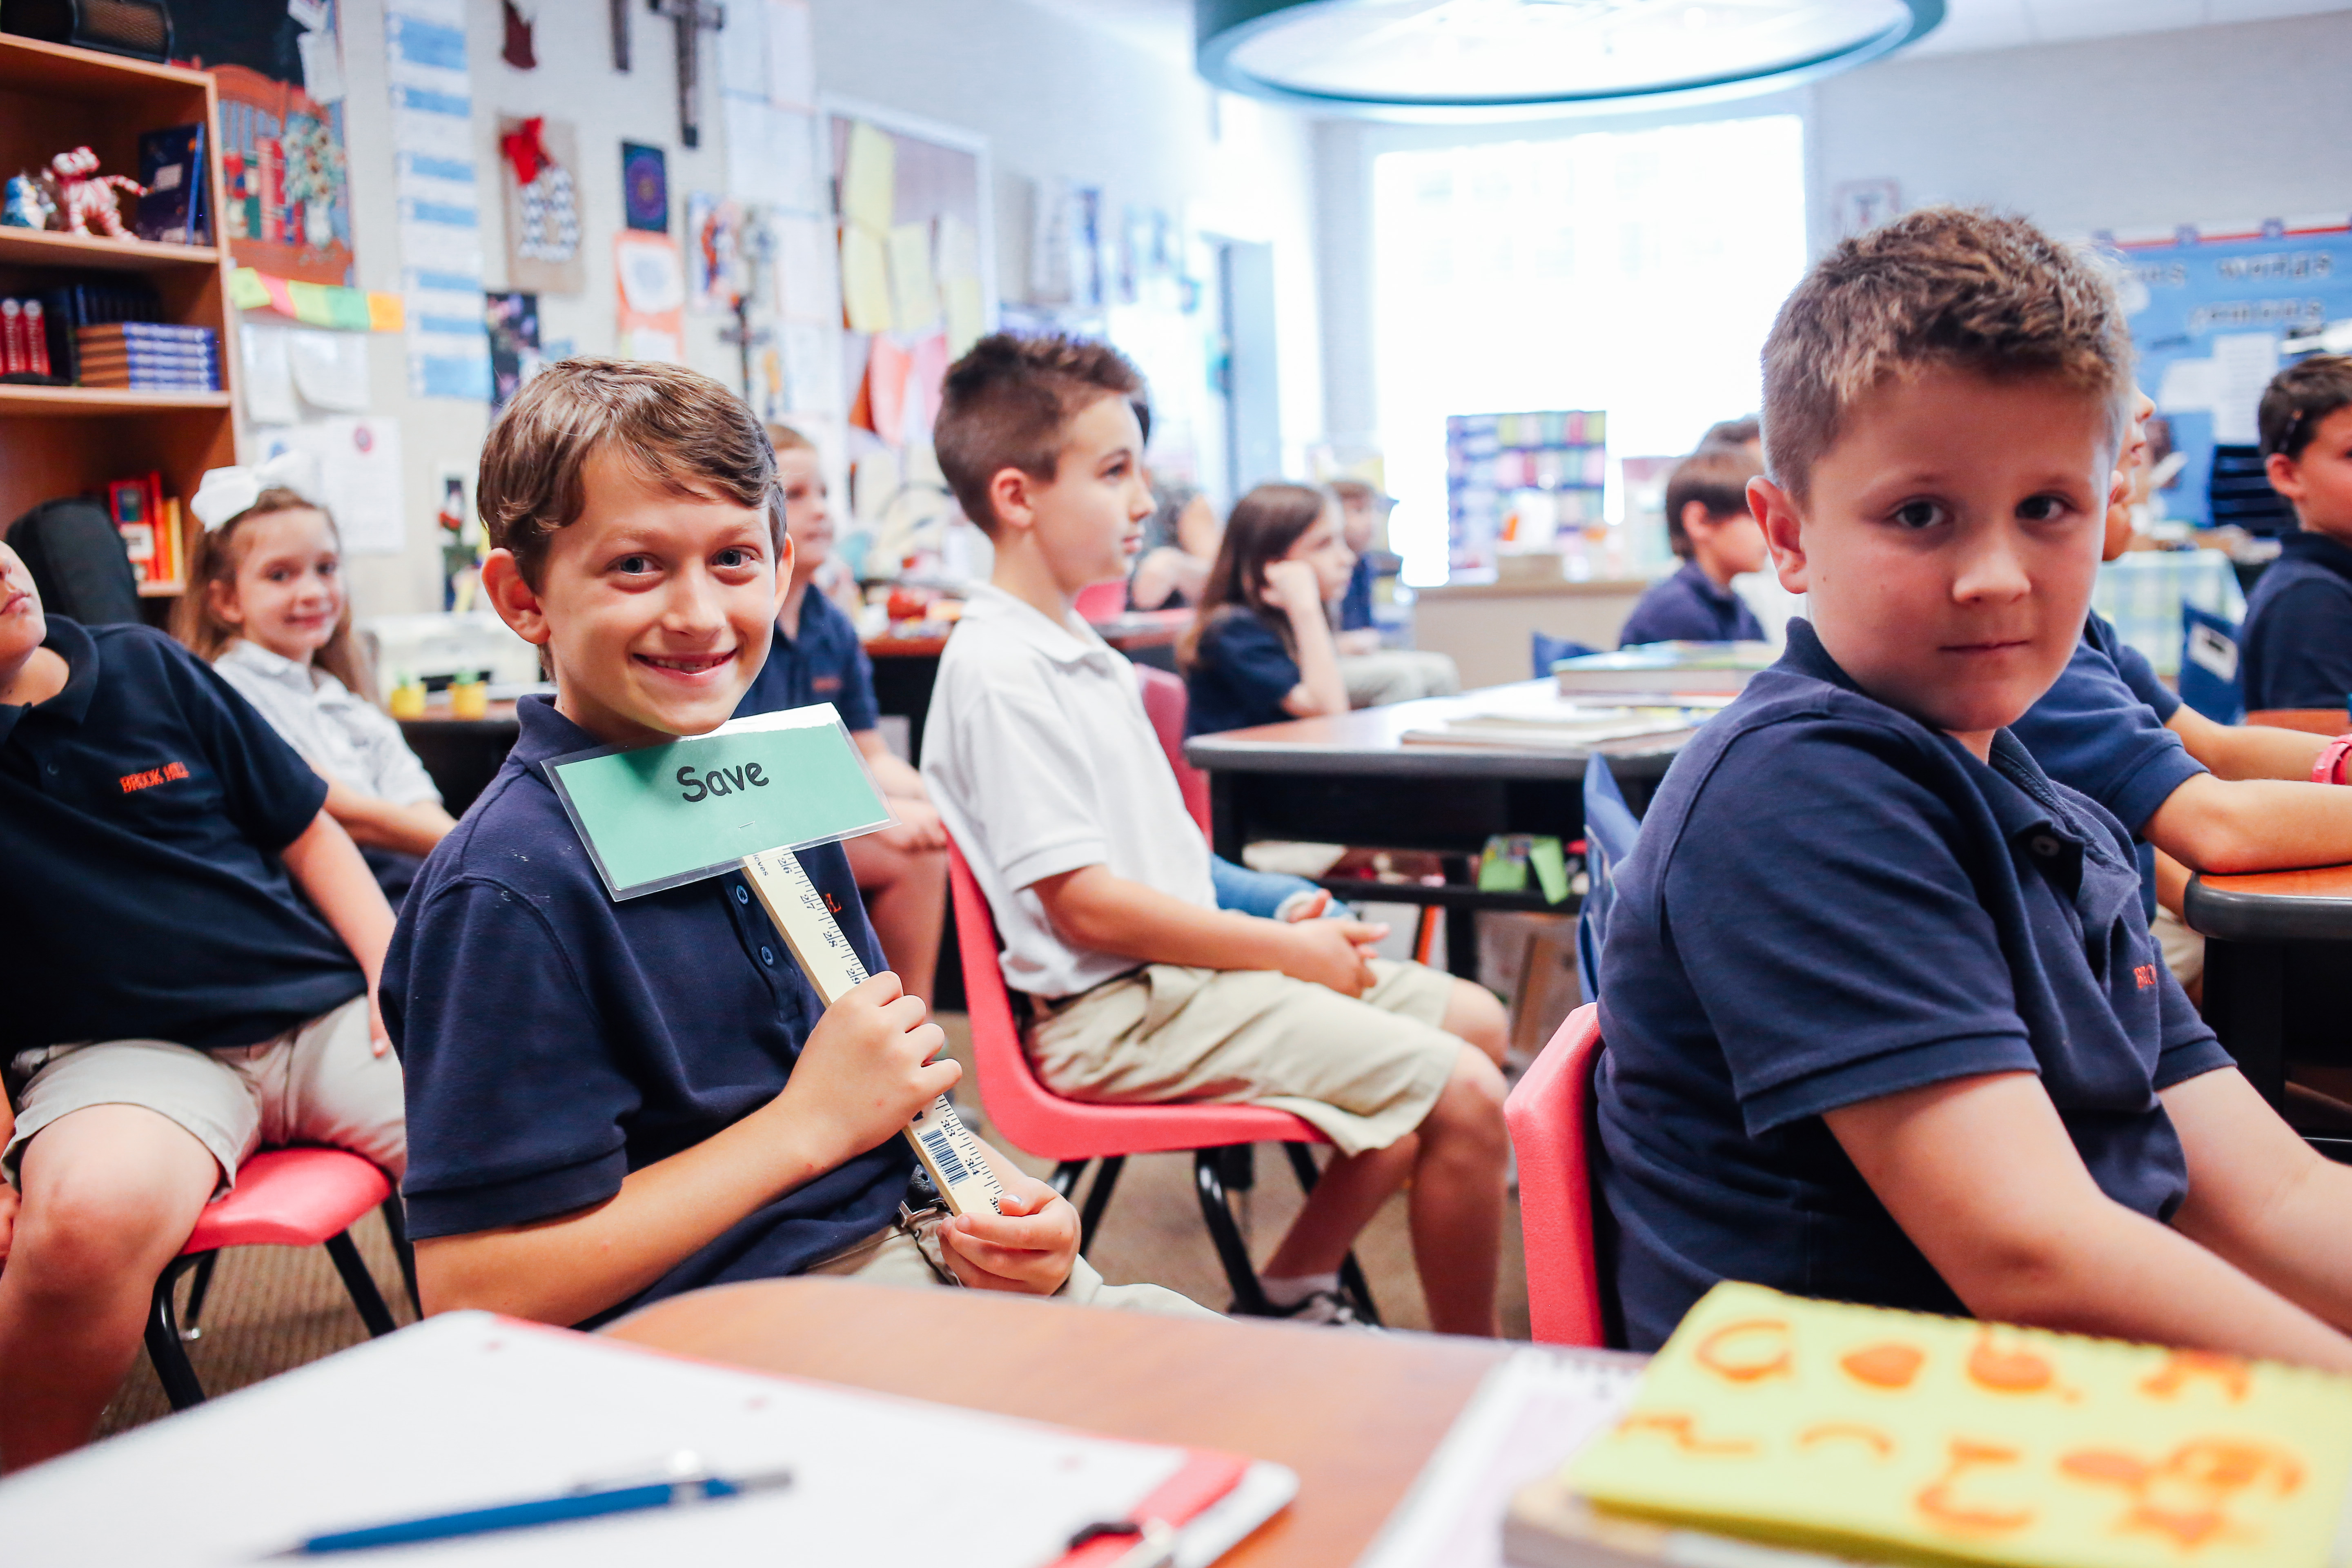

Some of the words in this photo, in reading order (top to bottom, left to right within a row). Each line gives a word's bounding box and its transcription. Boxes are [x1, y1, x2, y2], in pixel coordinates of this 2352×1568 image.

[677, 762, 769, 803] Save
[777, 858, 792, 873] 26
[800, 894, 815, 909] 27
[823, 931, 837, 947] 28
[846, 968, 861, 984] 29
[941, 1120, 955, 1137] 33
[965, 1158, 980, 1176] 34
